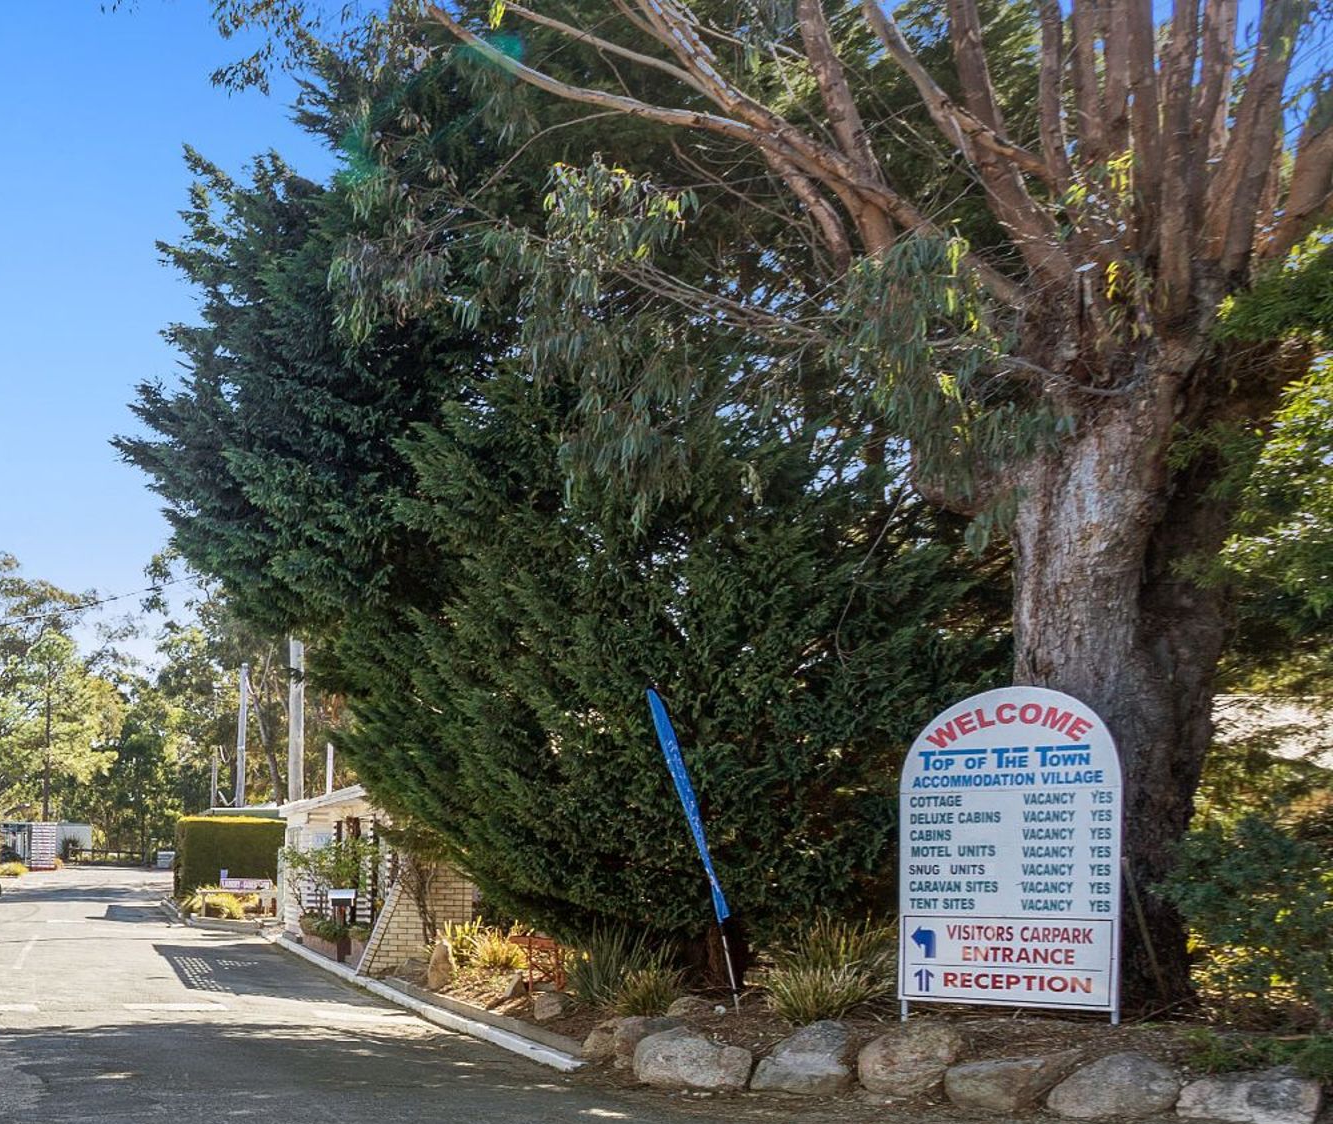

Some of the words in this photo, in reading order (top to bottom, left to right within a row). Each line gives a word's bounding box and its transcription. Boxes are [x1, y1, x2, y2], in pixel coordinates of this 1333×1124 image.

[925, 703, 1094, 749] WELCOME
[912, 773, 1036, 789] ACCOMMODATION
[1041, 770, 1103, 785] VILLAGE
[909, 795, 963, 808] COTTAGE
[1023, 792, 1076, 805] VACANCY
[1091, 791, 1113, 804] YES
[910, 812, 954, 825] DELUXE
[958, 811, 1001, 824] CABINS
[1023, 810, 1076, 823] VACANCY
[1090, 809, 1113, 822] YES
[909, 829, 952, 842] CABINS
[1022, 828, 1075, 841] VACANCY
[1090, 827, 1112, 840] YES
[911, 846, 952, 858] MOTEL
[957, 845, 996, 857] UNITS
[1022, 846, 1075, 859] VACANCY
[1089, 846, 1112, 859] YES
[908, 864, 940, 875] SNUG
[950, 864, 986, 875] UNITS
[1021, 863, 1074, 876] VACANCY
[1089, 863, 1111, 876] YES
[909, 881, 961, 893] CARAVAN
[965, 880, 998, 893] SITES
[1021, 881, 1074, 894] VACANCY
[1088, 881, 1111, 895] YES
[910, 898, 938, 910] TENT
[942, 898, 975, 910] SITES
[1021, 899, 1073, 912] VACANCY
[1088, 899, 1111, 913] YES
[946, 924, 1014, 942] VISITORS
[1020, 926, 1094, 945] CARPARK
[961, 946, 1075, 965] ENTRANCE
[943, 972, 1092, 994] RECEPTION
